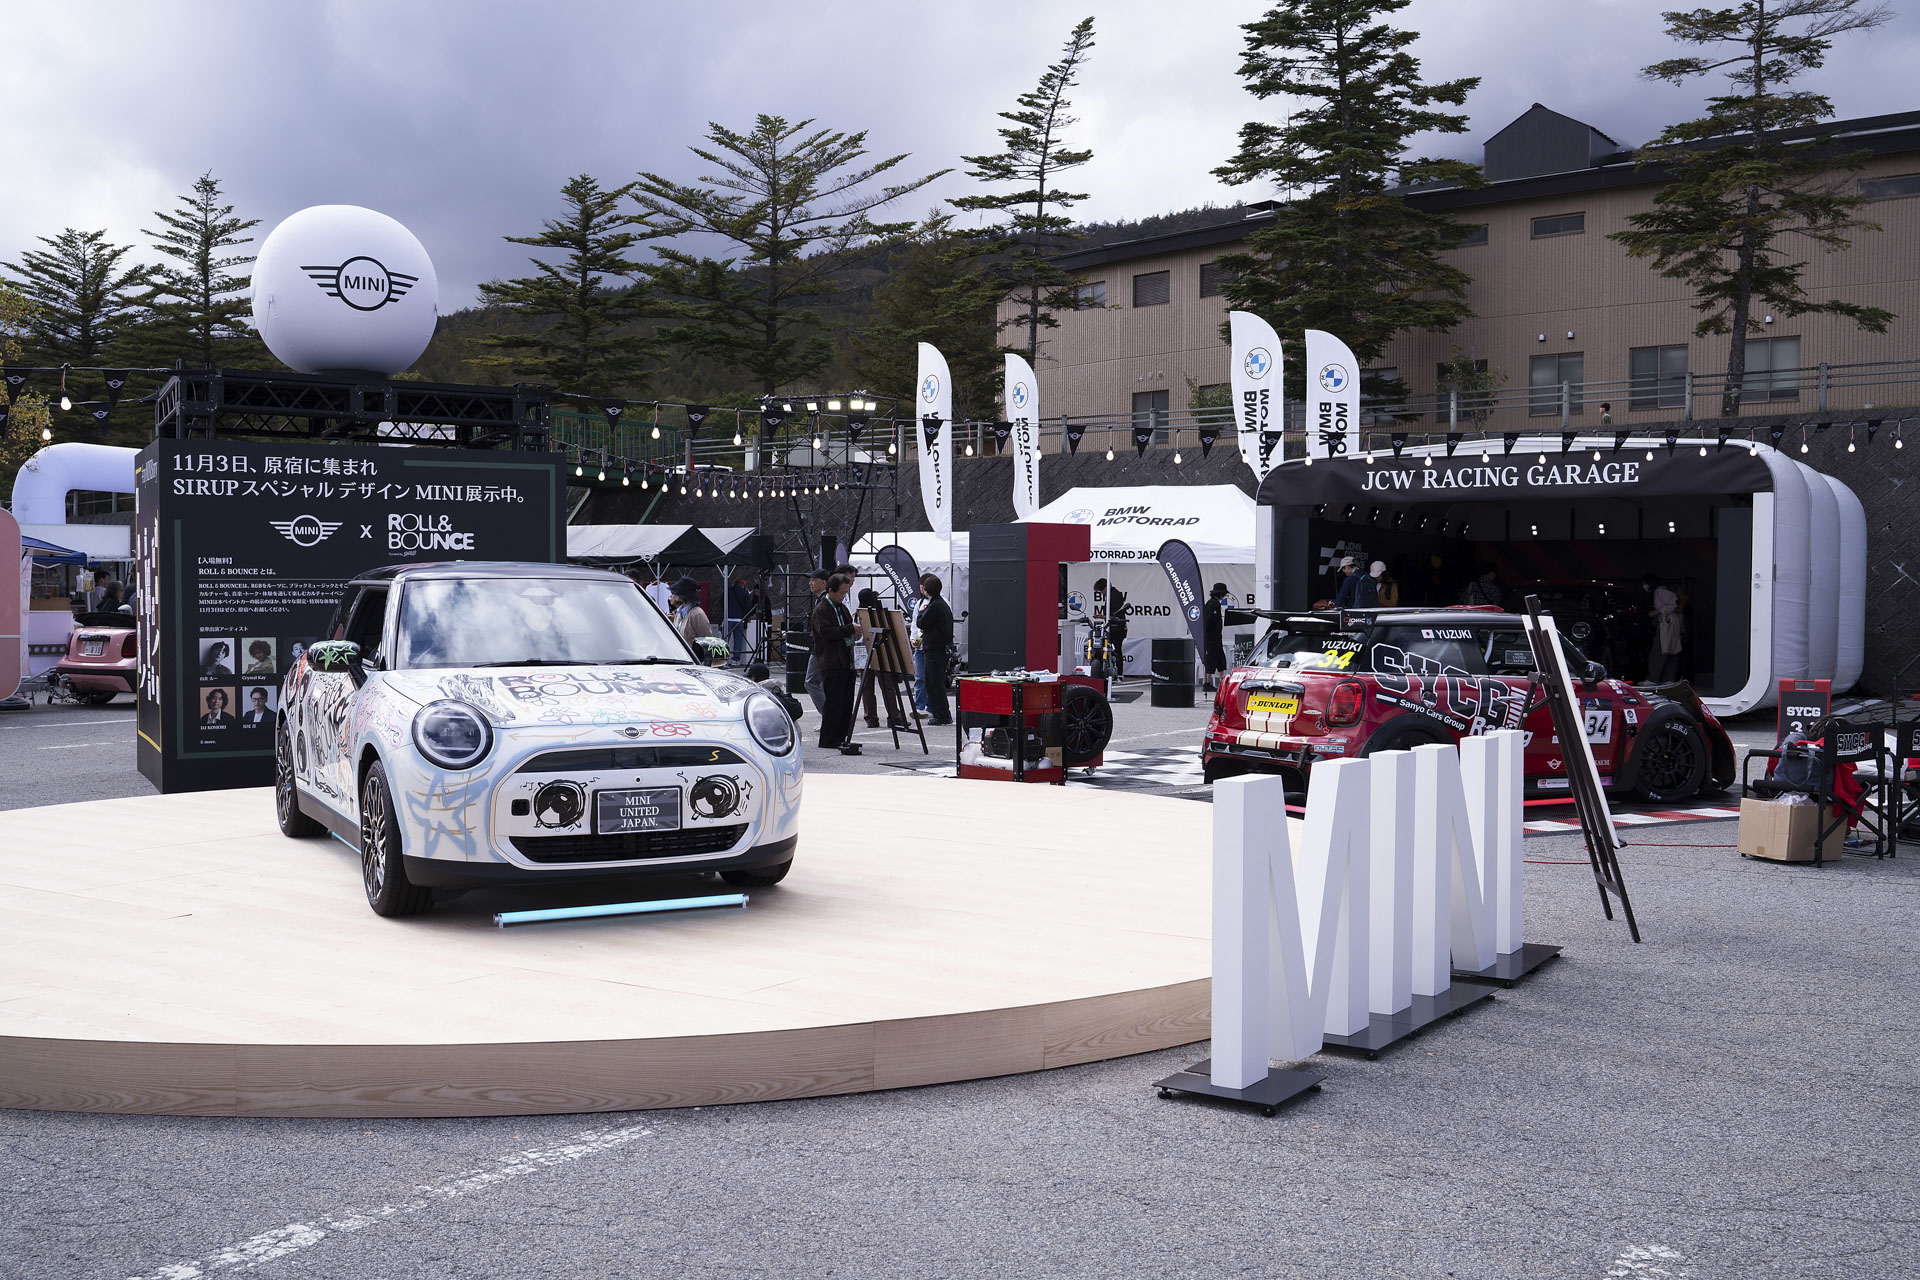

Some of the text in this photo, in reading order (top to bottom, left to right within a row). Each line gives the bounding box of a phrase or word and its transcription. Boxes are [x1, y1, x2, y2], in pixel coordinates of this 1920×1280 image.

[344, 275, 385, 292] MINI
[173, 454, 378, 476] 11月3日、原宿に集まれ
[1361, 462, 1640, 491] JCW RACING GARAGE
[1104, 506, 1151, 516] BMW
[1096, 516, 1200, 526] MOTORRAD
[295, 526, 319, 535] MINI
[388, 532, 475, 550] BOUNCE
[1435, 629, 1473, 639] YUZUKI
[1321, 641, 1363, 652] YUZUKI
[1317, 649, 1355, 670] 34
[508, 682, 707, 701] BOUNCE
[1257, 700, 1293, 709] DUNLOP
[1399, 699, 1466, 731] Sanyo Cars Group
[1786, 706, 1821, 717] SYCG
[1586, 715, 1610, 737] 34
[1837, 732, 1866, 751] SYCG
[708, 750, 720, 762] S
[625, 796, 651, 806] MINI
[619, 806, 660, 817] UNITED
[621, 818, 658, 828] JAPAN.
[1211, 729, 1524, 1089] MINI
